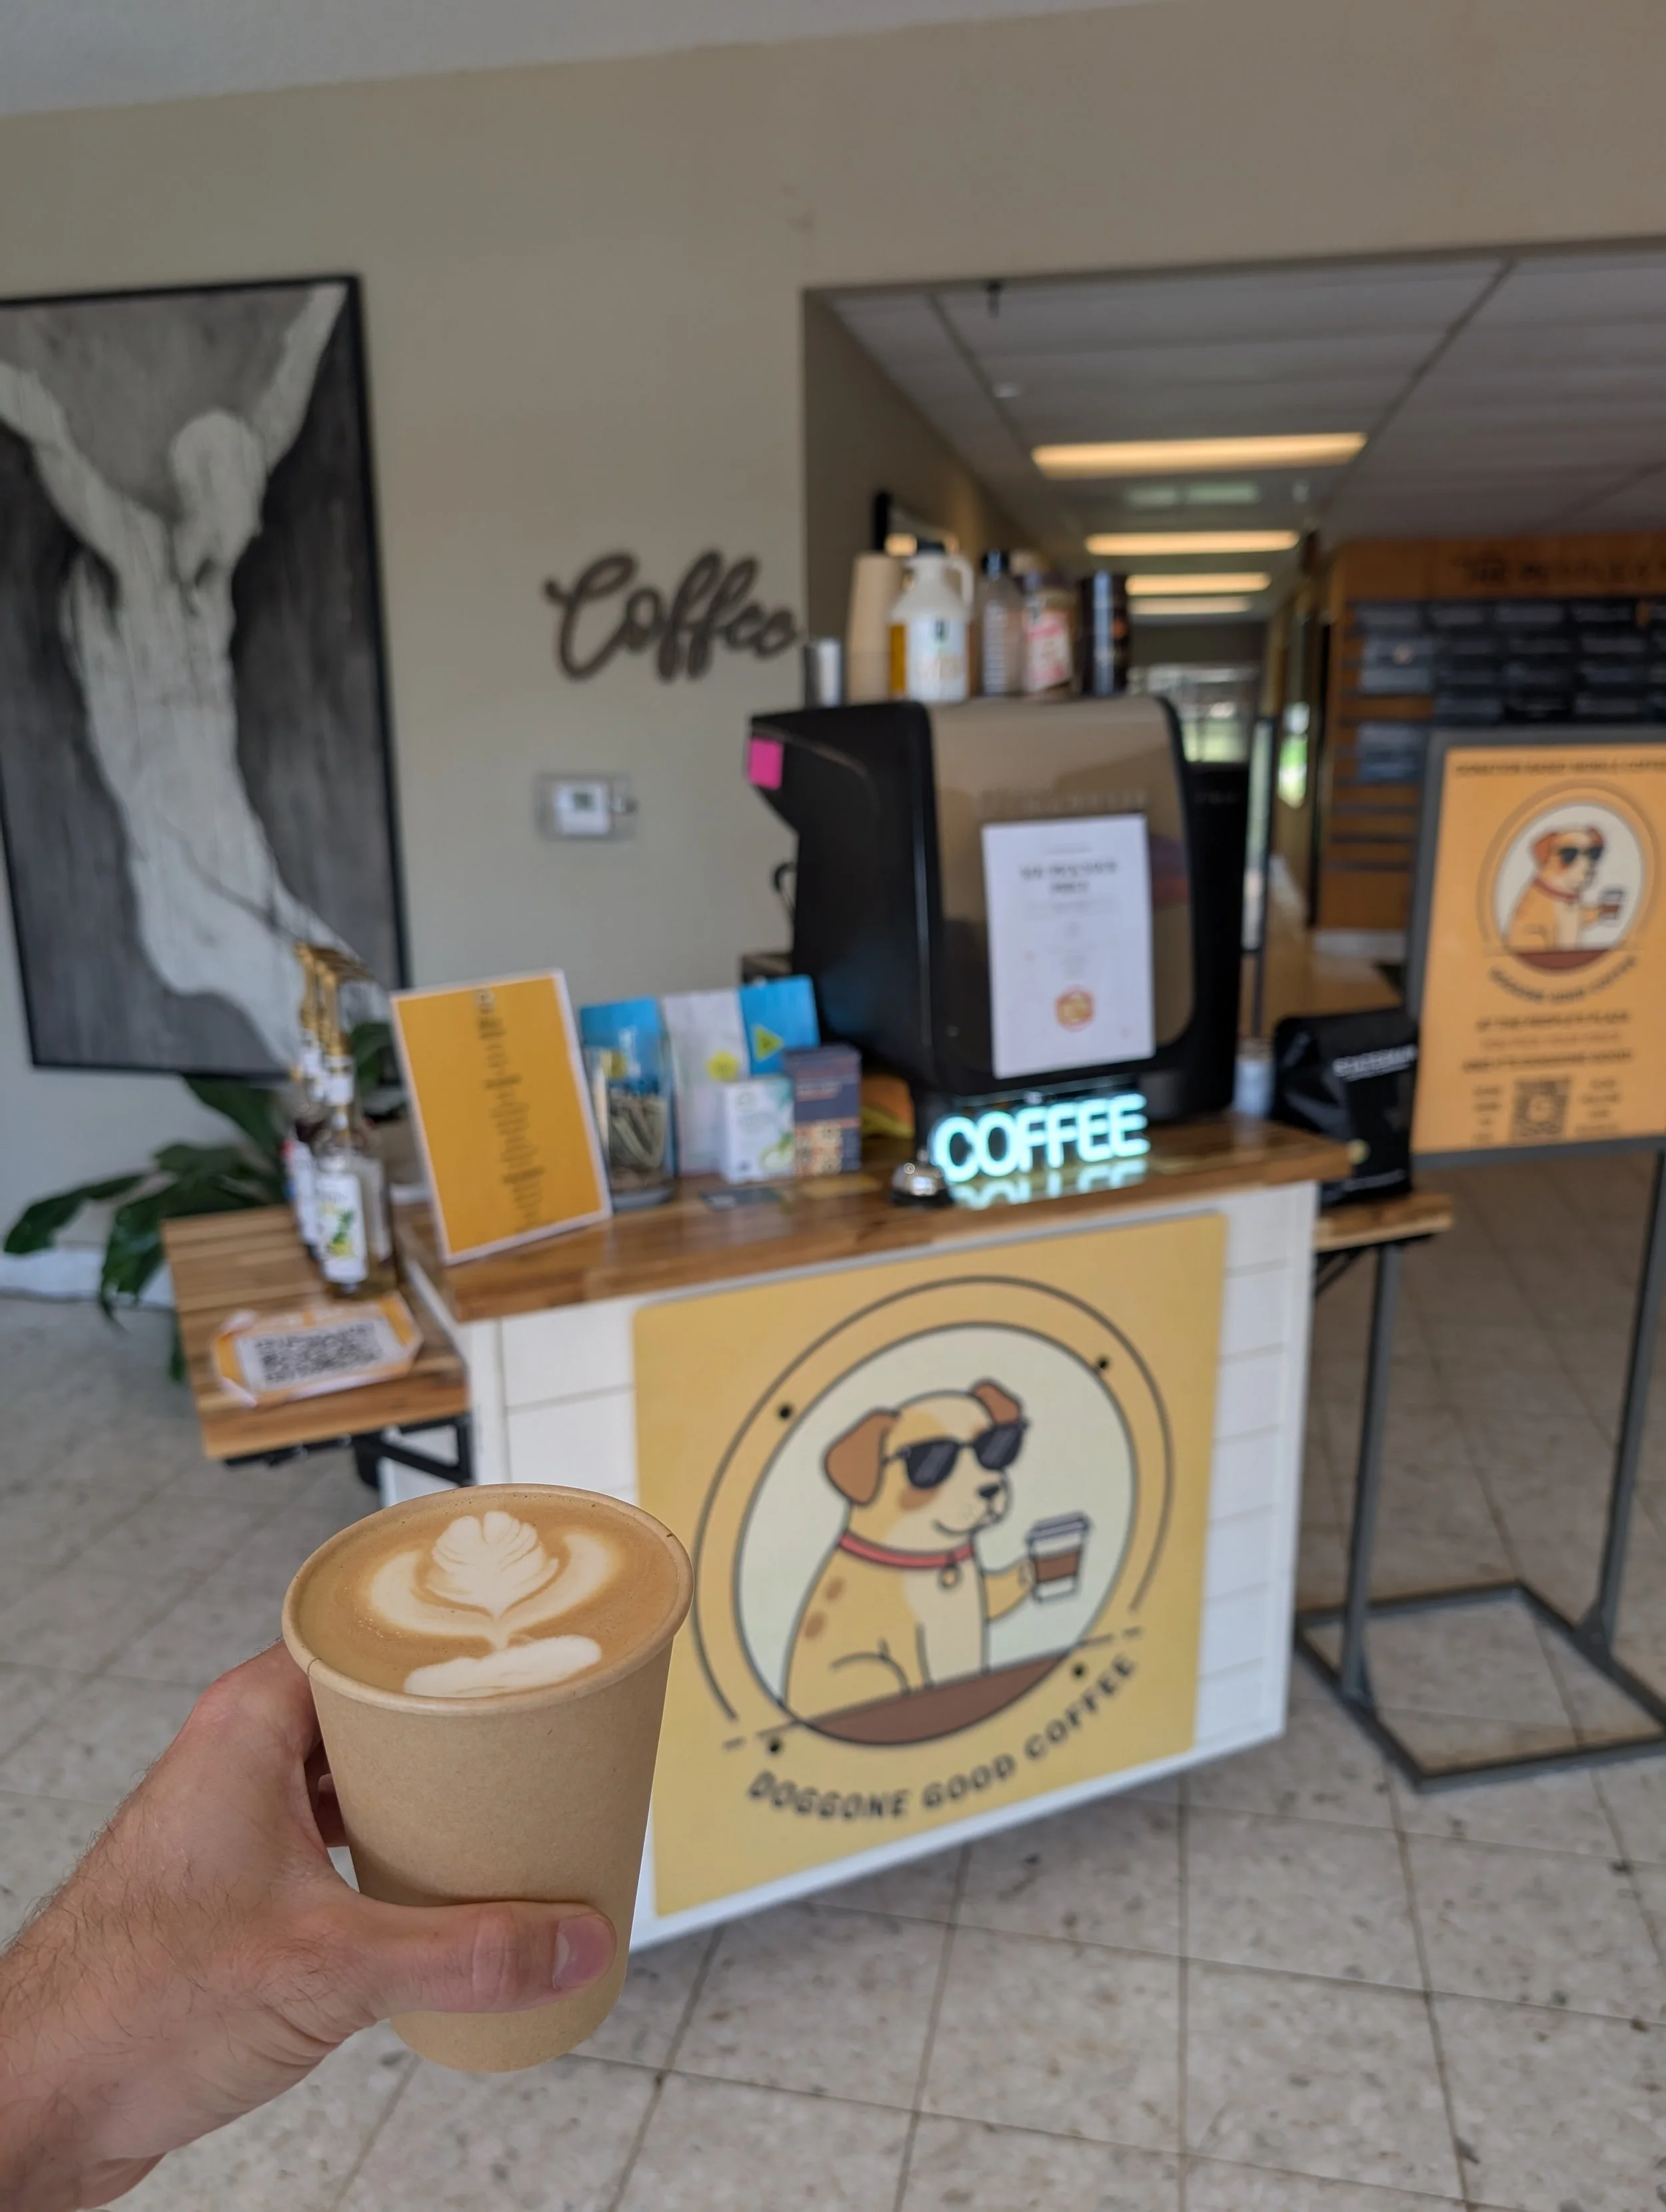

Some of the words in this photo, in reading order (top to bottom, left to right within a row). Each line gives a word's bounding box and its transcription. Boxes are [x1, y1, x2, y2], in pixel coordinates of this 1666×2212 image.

[544, 549, 800, 682] Coffee
[932, 1093, 1150, 1183] COFFEE
[747, 1769, 909, 1822] DOGGONE
[922, 1754, 1016, 1808] GOOD
[1024, 1654, 1135, 1761] COFFEE
